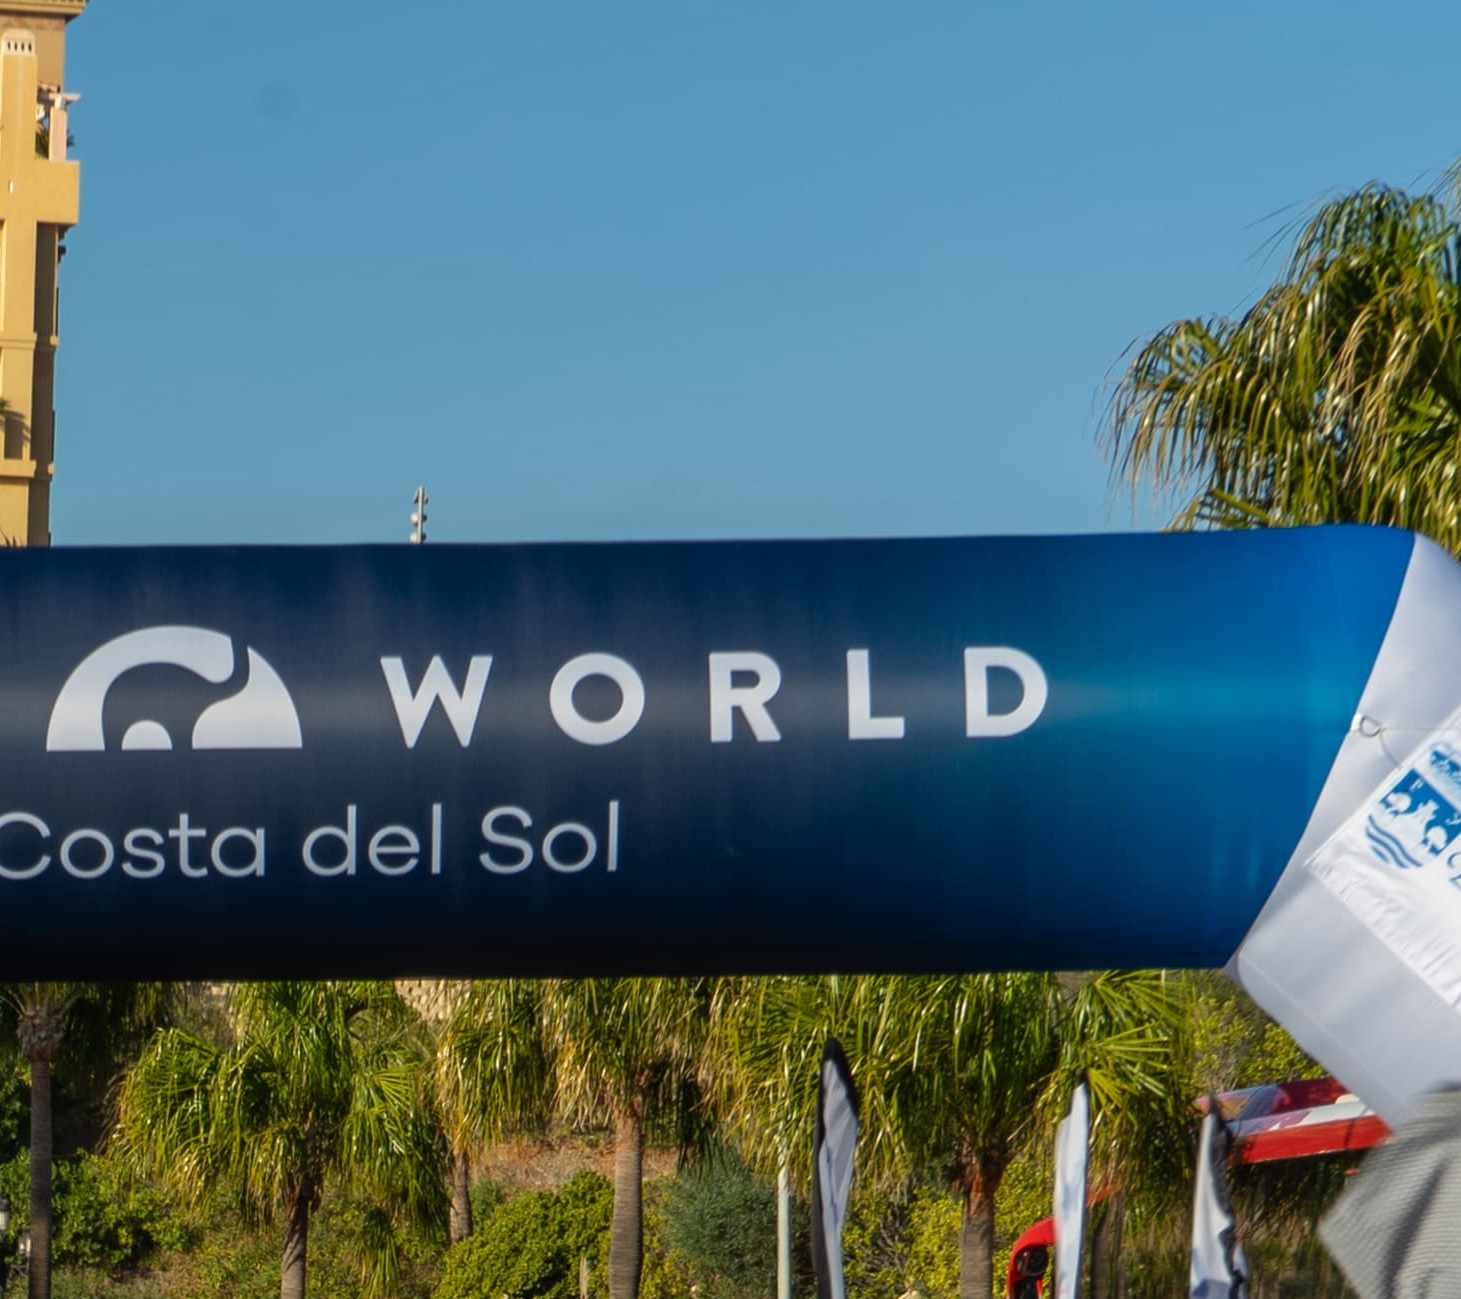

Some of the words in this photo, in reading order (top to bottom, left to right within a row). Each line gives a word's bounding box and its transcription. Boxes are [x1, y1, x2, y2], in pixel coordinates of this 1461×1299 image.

[381, 646, 1049, 748] WORLD
[301, 803, 443, 877] del
[479, 799, 621, 875] Sol
